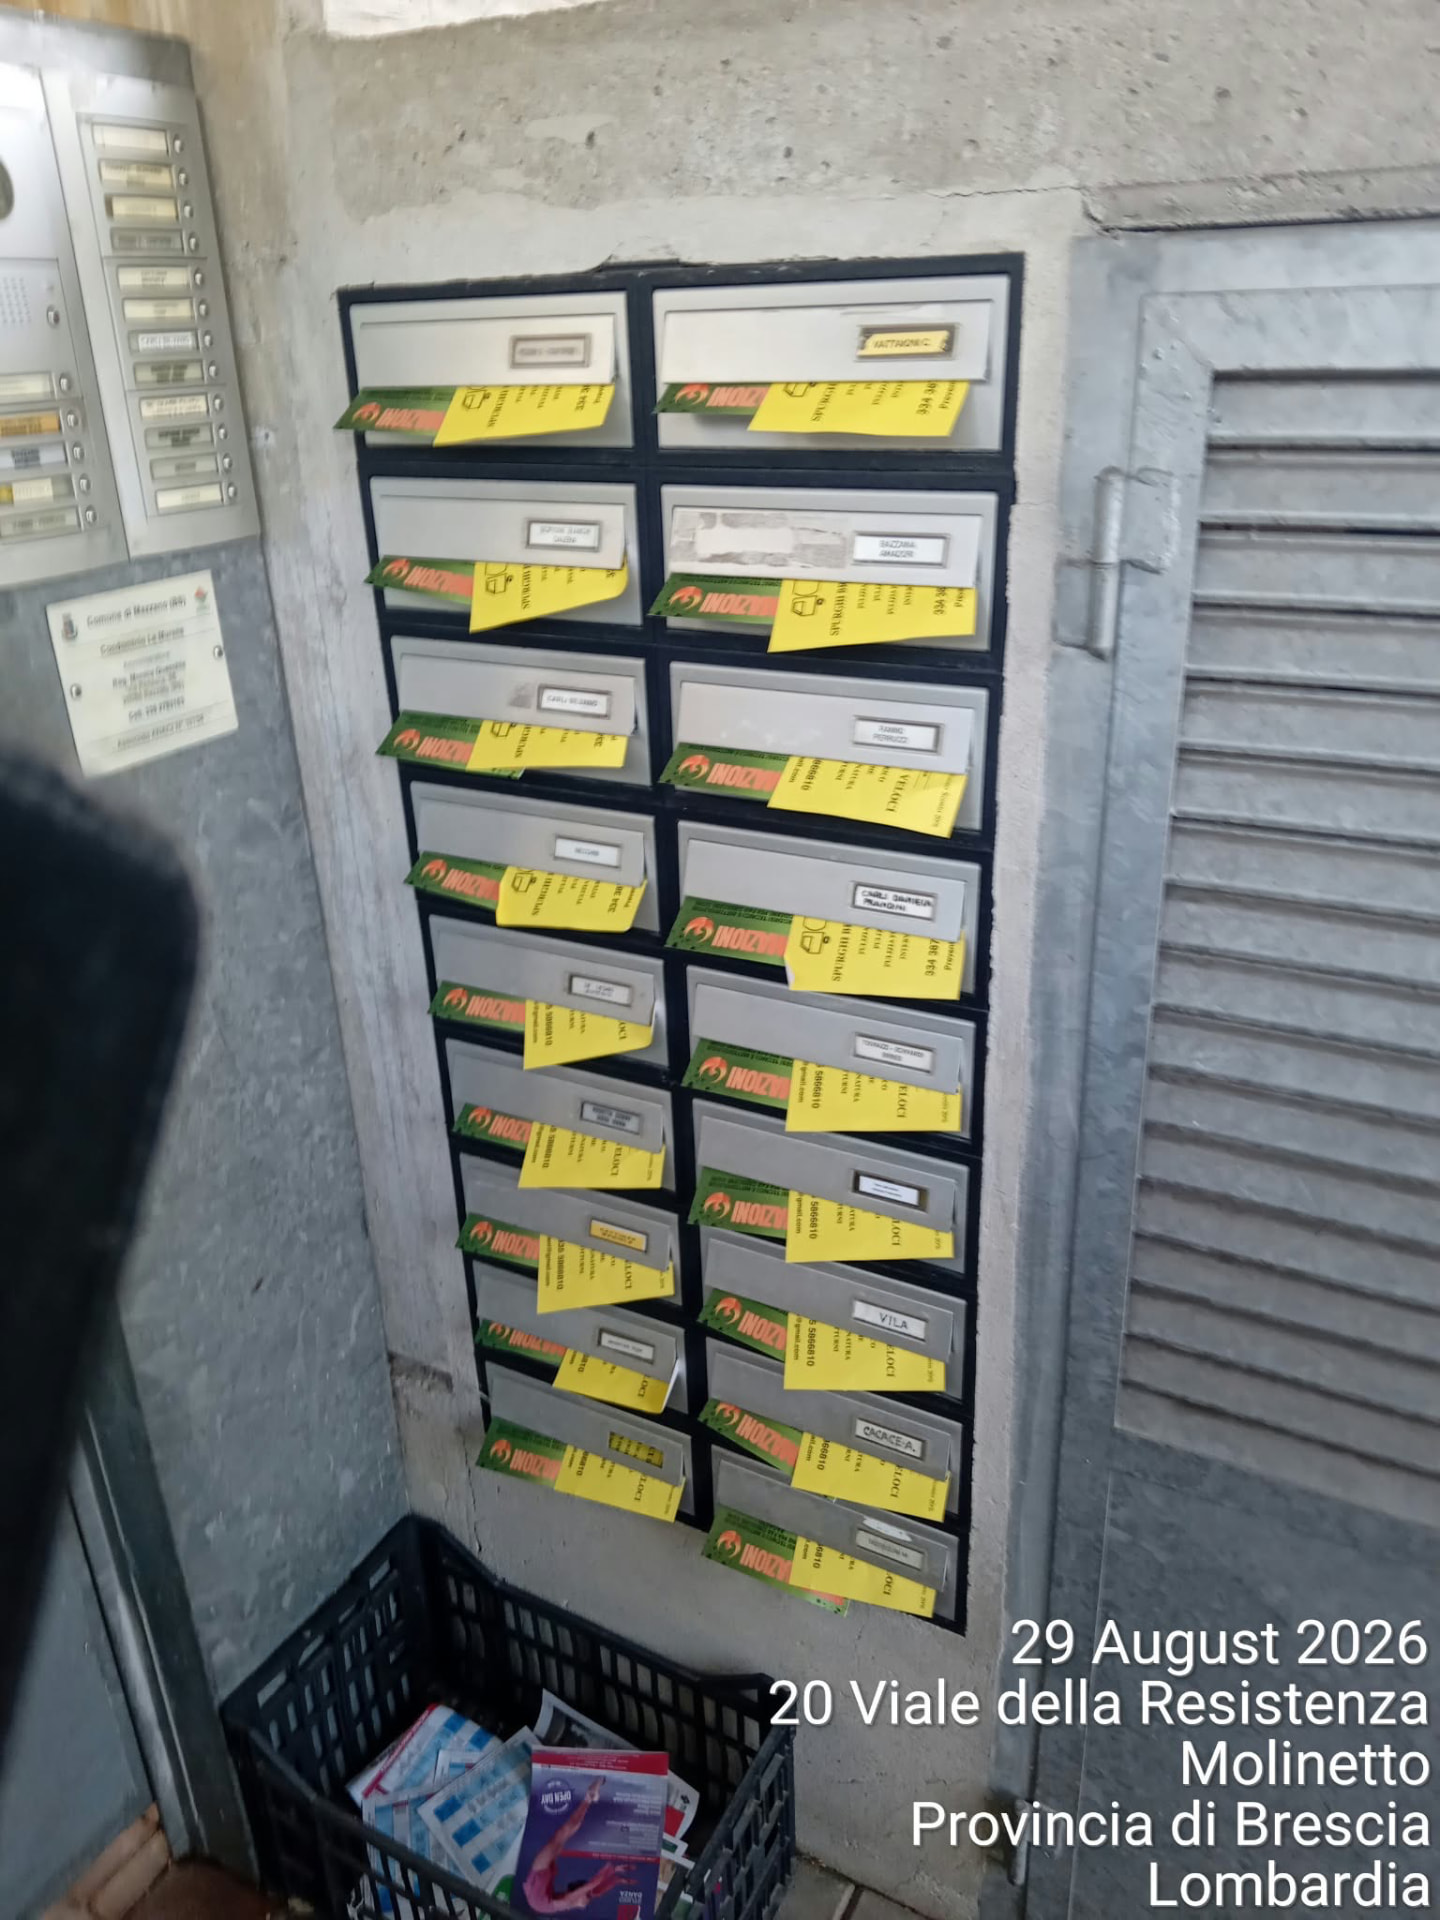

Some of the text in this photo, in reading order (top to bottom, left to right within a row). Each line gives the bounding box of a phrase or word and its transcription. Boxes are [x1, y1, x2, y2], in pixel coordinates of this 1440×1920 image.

[885, 774, 909, 812] VELOCI
[831, 936, 850, 981] SPURGHI
[925, 959, 937, 976] 334
[812, 1070, 824, 1109] 5866810
[808, 1201, 819, 1239] 5866810
[879, 1312, 908, 1330] VILA
[806, 1327, 816, 1367] 5866810
